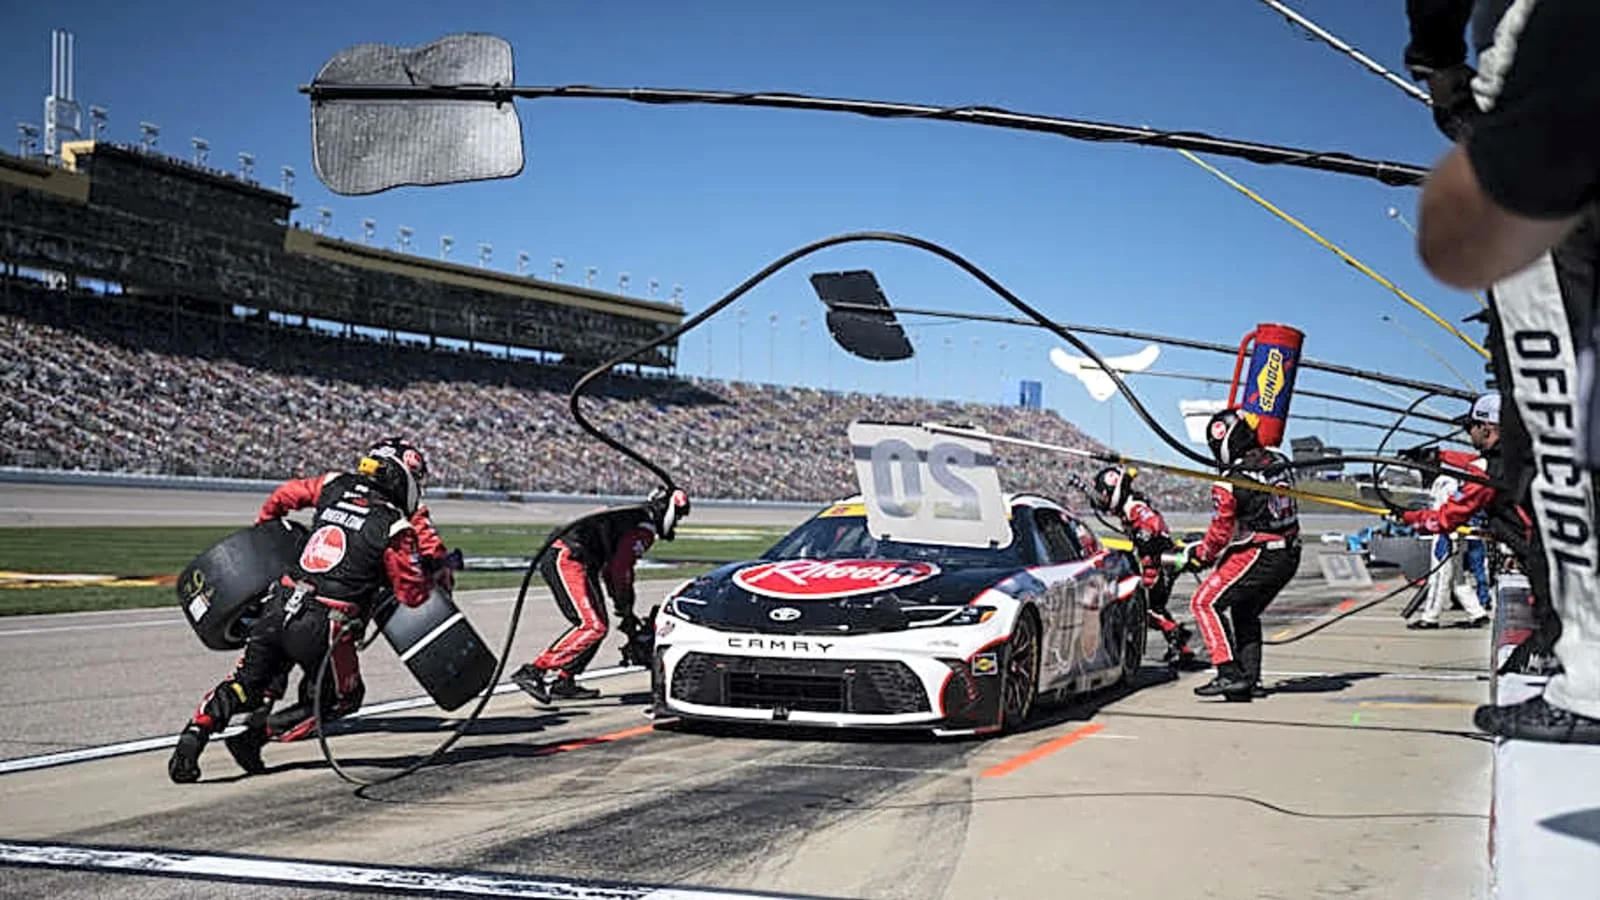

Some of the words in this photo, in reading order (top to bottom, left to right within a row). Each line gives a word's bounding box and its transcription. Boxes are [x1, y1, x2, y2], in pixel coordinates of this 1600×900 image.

[1262, 351, 1282, 409] SUNOCO
[1514, 330, 1592, 567] OFFICIAL
[728, 637, 834, 654] CAMRY
